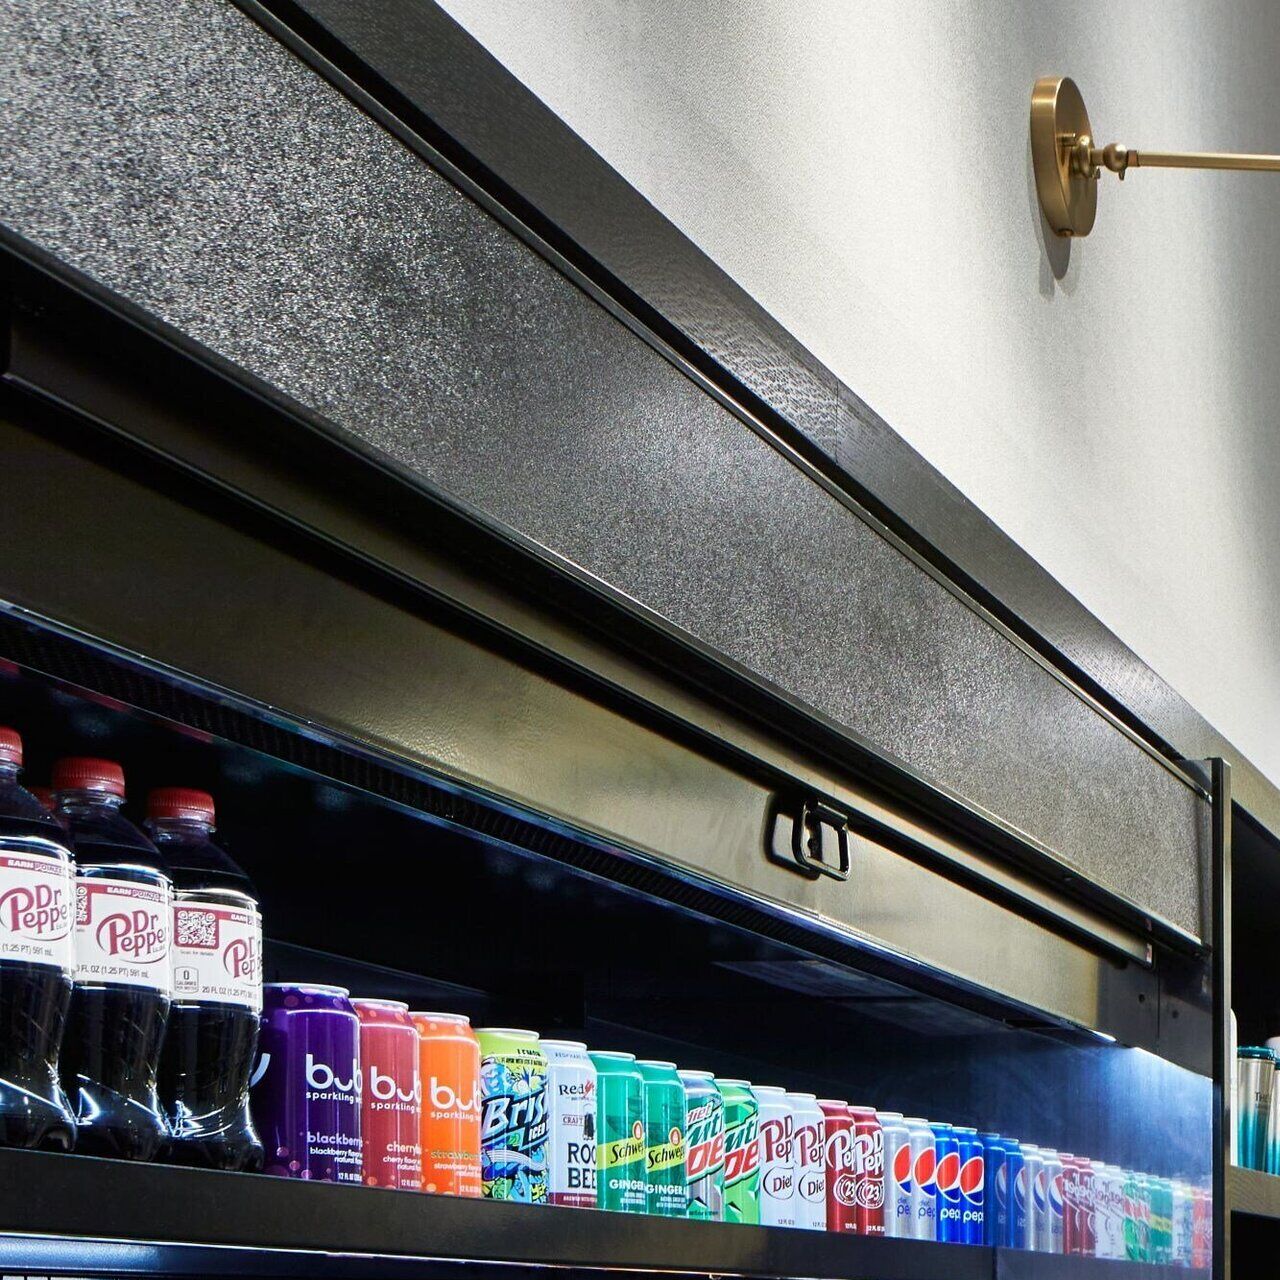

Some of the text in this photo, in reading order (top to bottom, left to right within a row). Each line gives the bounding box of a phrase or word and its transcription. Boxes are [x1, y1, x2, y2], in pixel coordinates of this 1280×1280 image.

[8, 859, 34, 869] EARN
[35, 884, 62, 909] Dr
[107, 886, 132, 896] EARN
[132, 910, 159, 935] Dr
[183, 970, 190, 980] 0
[559, 1082, 584, 1096] Red
[306, 1091, 354, 1104] sparkling
[371, 1102, 416, 1114] sparkling
[430, 1110, 475, 1123] sparkling
[562, 1116, 584, 1125] CRAFT
[310, 1147, 348, 1157] blackberry
[383, 1156, 404, 1165] cherry
[773, 1175, 793, 1192] Diet
